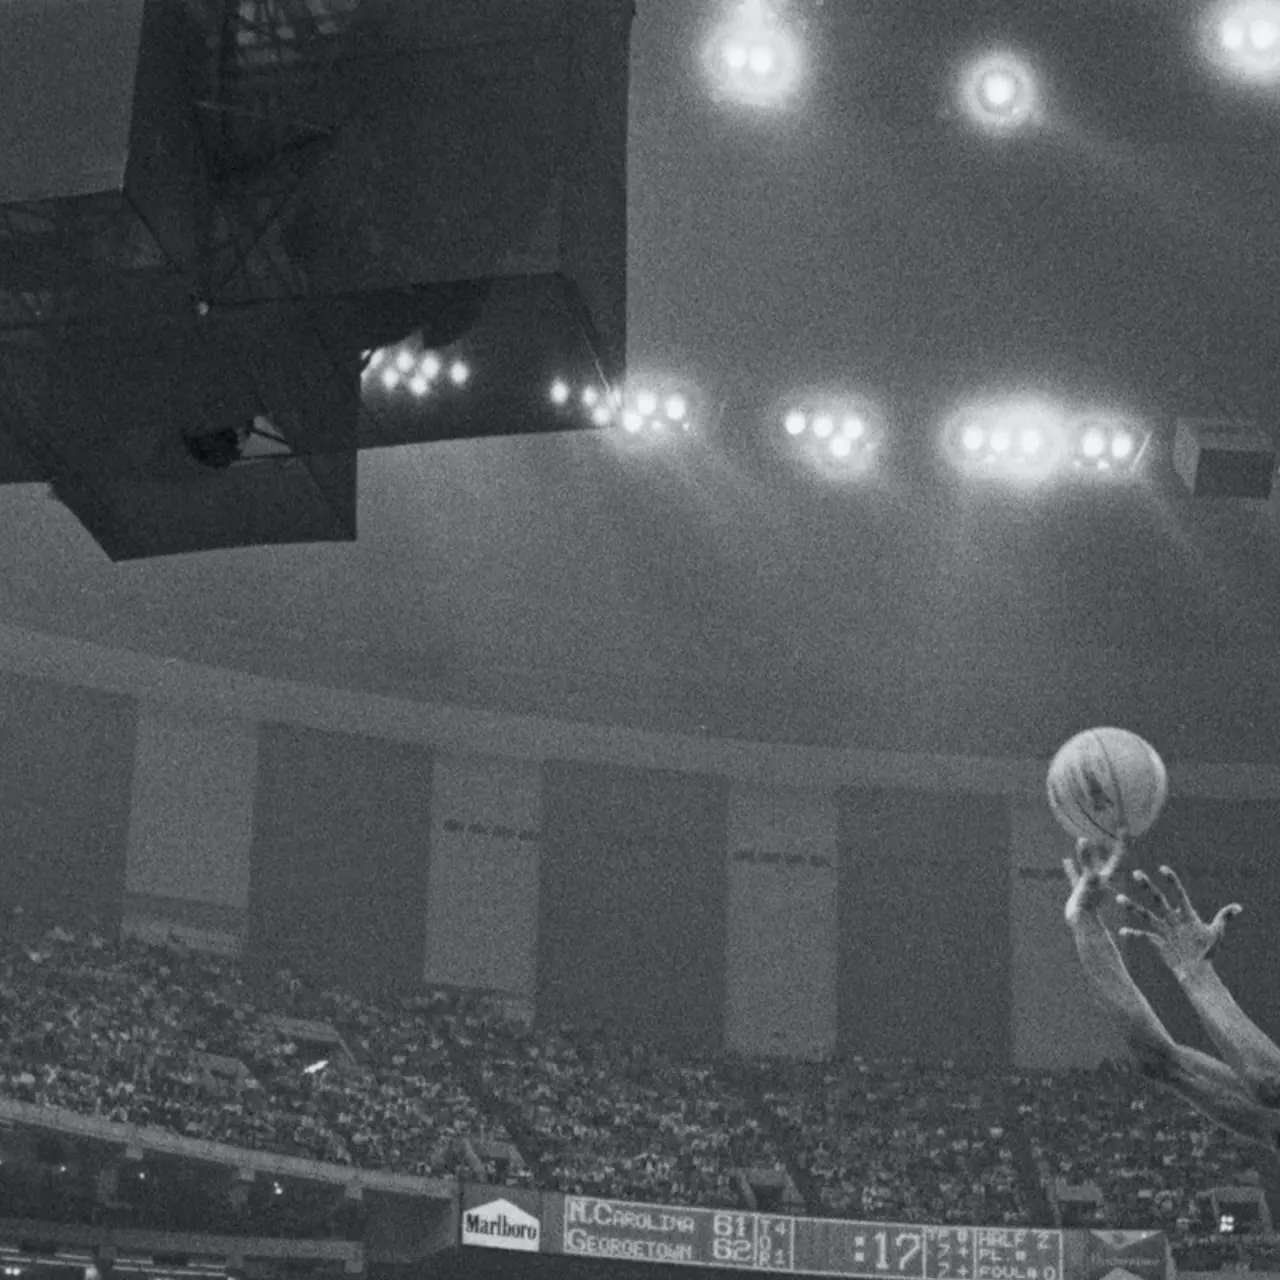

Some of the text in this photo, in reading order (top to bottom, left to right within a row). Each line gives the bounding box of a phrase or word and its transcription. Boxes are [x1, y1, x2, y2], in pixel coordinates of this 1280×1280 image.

[465, 1213, 537, 1240] Marlboro
[713, 1212, 746, 1237] 61
[713, 1238, 752, 1261] 62
[853, 1231, 921, 1271] :17
